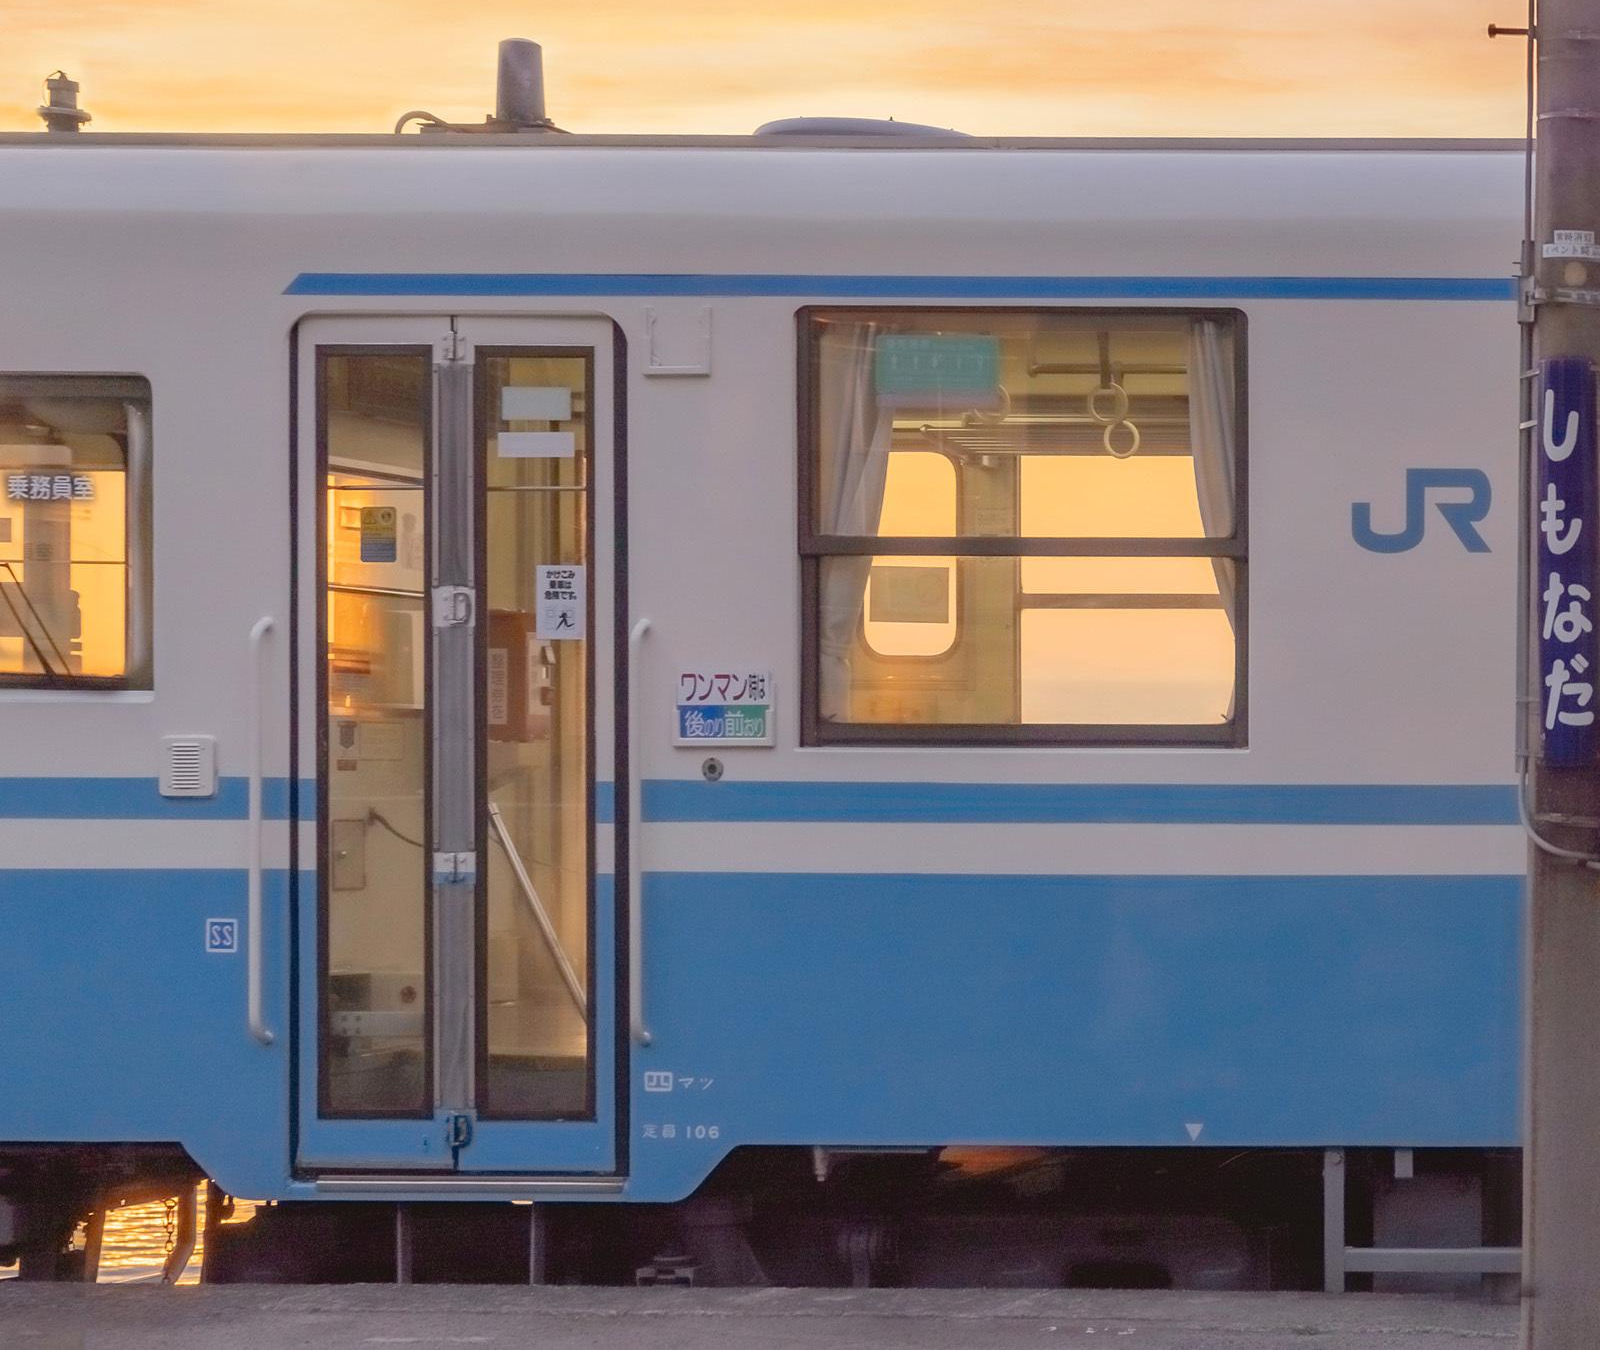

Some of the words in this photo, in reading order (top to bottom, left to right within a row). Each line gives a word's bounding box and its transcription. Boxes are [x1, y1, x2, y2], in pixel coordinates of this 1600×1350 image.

[7, 475, 95, 500] 乗務員室
[1352, 468, 1492, 554] JR
[1541, 388, 1595, 731] しもなだ
[681, 673, 766, 701] ワンマン時は
[212, 925, 232, 945] SS
[686, 1125, 720, 1139] 106
